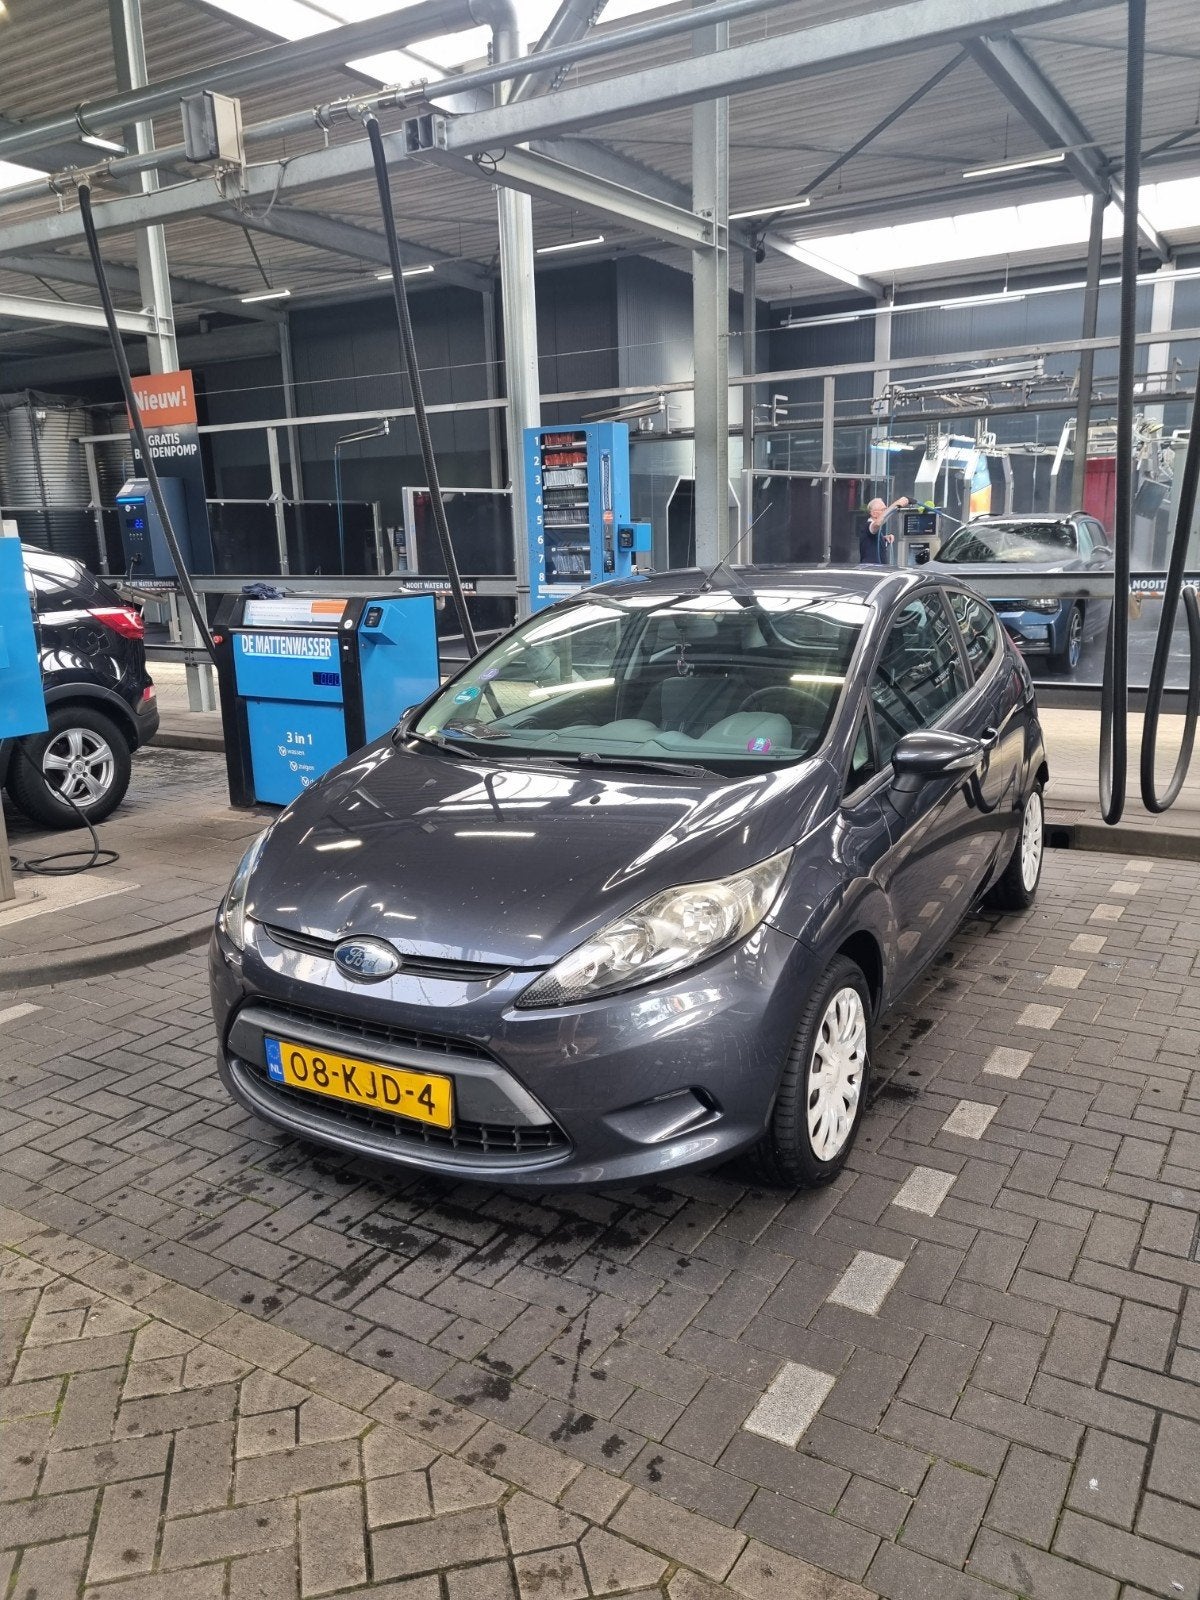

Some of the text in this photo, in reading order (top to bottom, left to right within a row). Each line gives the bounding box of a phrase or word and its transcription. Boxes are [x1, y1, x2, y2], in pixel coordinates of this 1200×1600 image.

[134, 385, 187, 411] Nieuw!
[148, 433, 180, 446] GRATIS
[534, 436, 539, 446] 1
[134, 443, 197, 459] BNDENPOMP
[533, 456, 540, 466] 2
[535, 475, 541, 485] 3
[535, 495, 542, 505] 4
[536, 515, 543, 525] 5
[537, 535, 544, 545] 6
[538, 554, 545, 563] 7
[539, 572, 545, 582] 8
[424, 581, 444, 589] WATER
[1132, 580, 1166, 590] NOOIT
[241, 634, 332, 657] DE MATTENWASSER
[286, 731, 313, 746] 3 in 1
[345, 947, 381, 969] Ford
[270, 1063, 282, 1075] NL
[290, 1052, 436, 1116] 08-KJD-4
